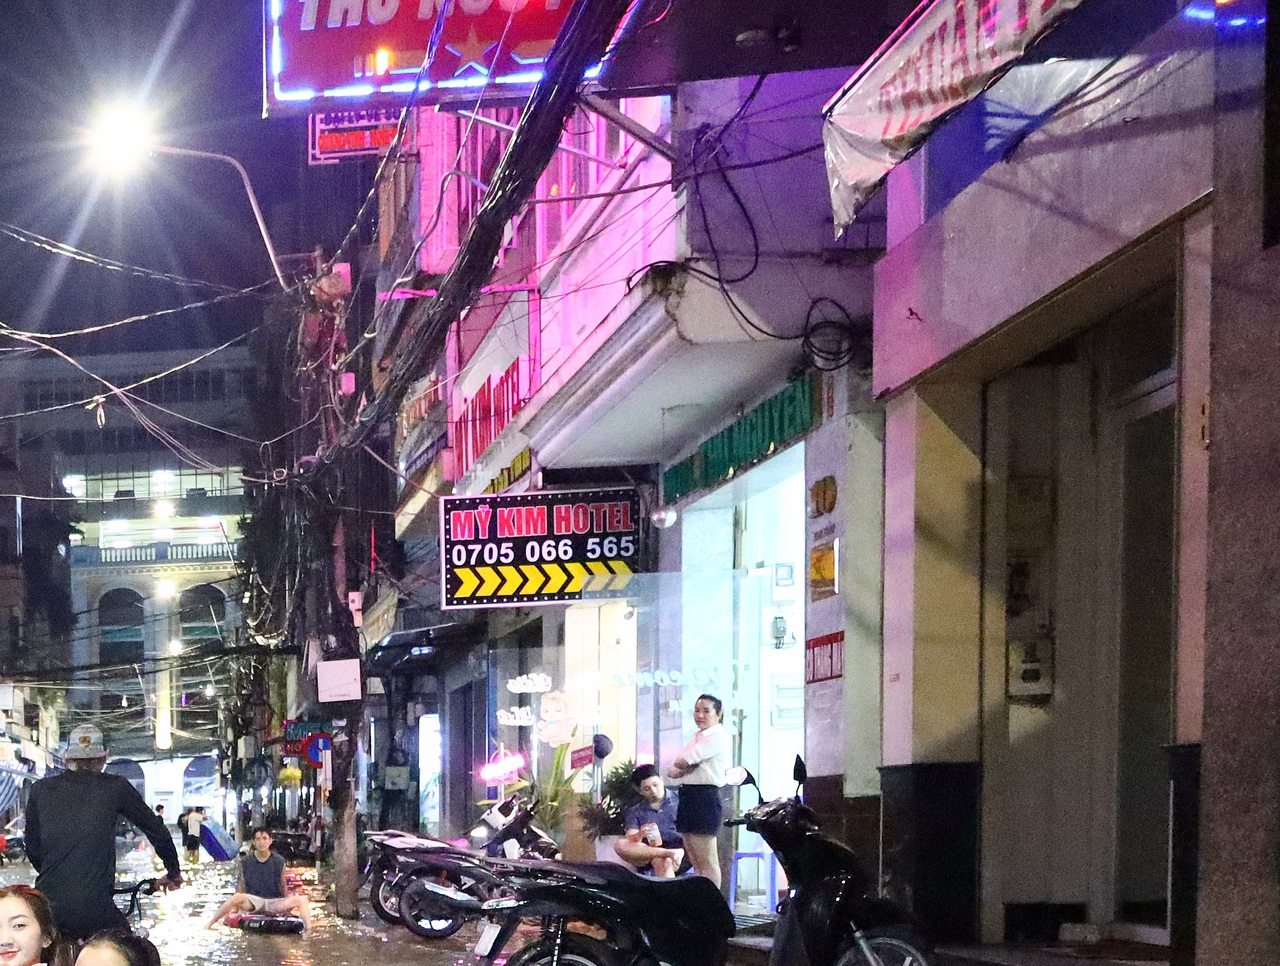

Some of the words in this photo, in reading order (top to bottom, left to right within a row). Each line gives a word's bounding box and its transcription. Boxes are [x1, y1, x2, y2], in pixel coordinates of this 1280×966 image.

[450, 504, 492, 541] MỸ
[496, 506, 548, 538] KIM
[553, 501, 635, 535] HOTEL
[452, 542, 515, 566] 0705
[525, 539, 573, 562] 066
[586, 536, 635, 559] 565
